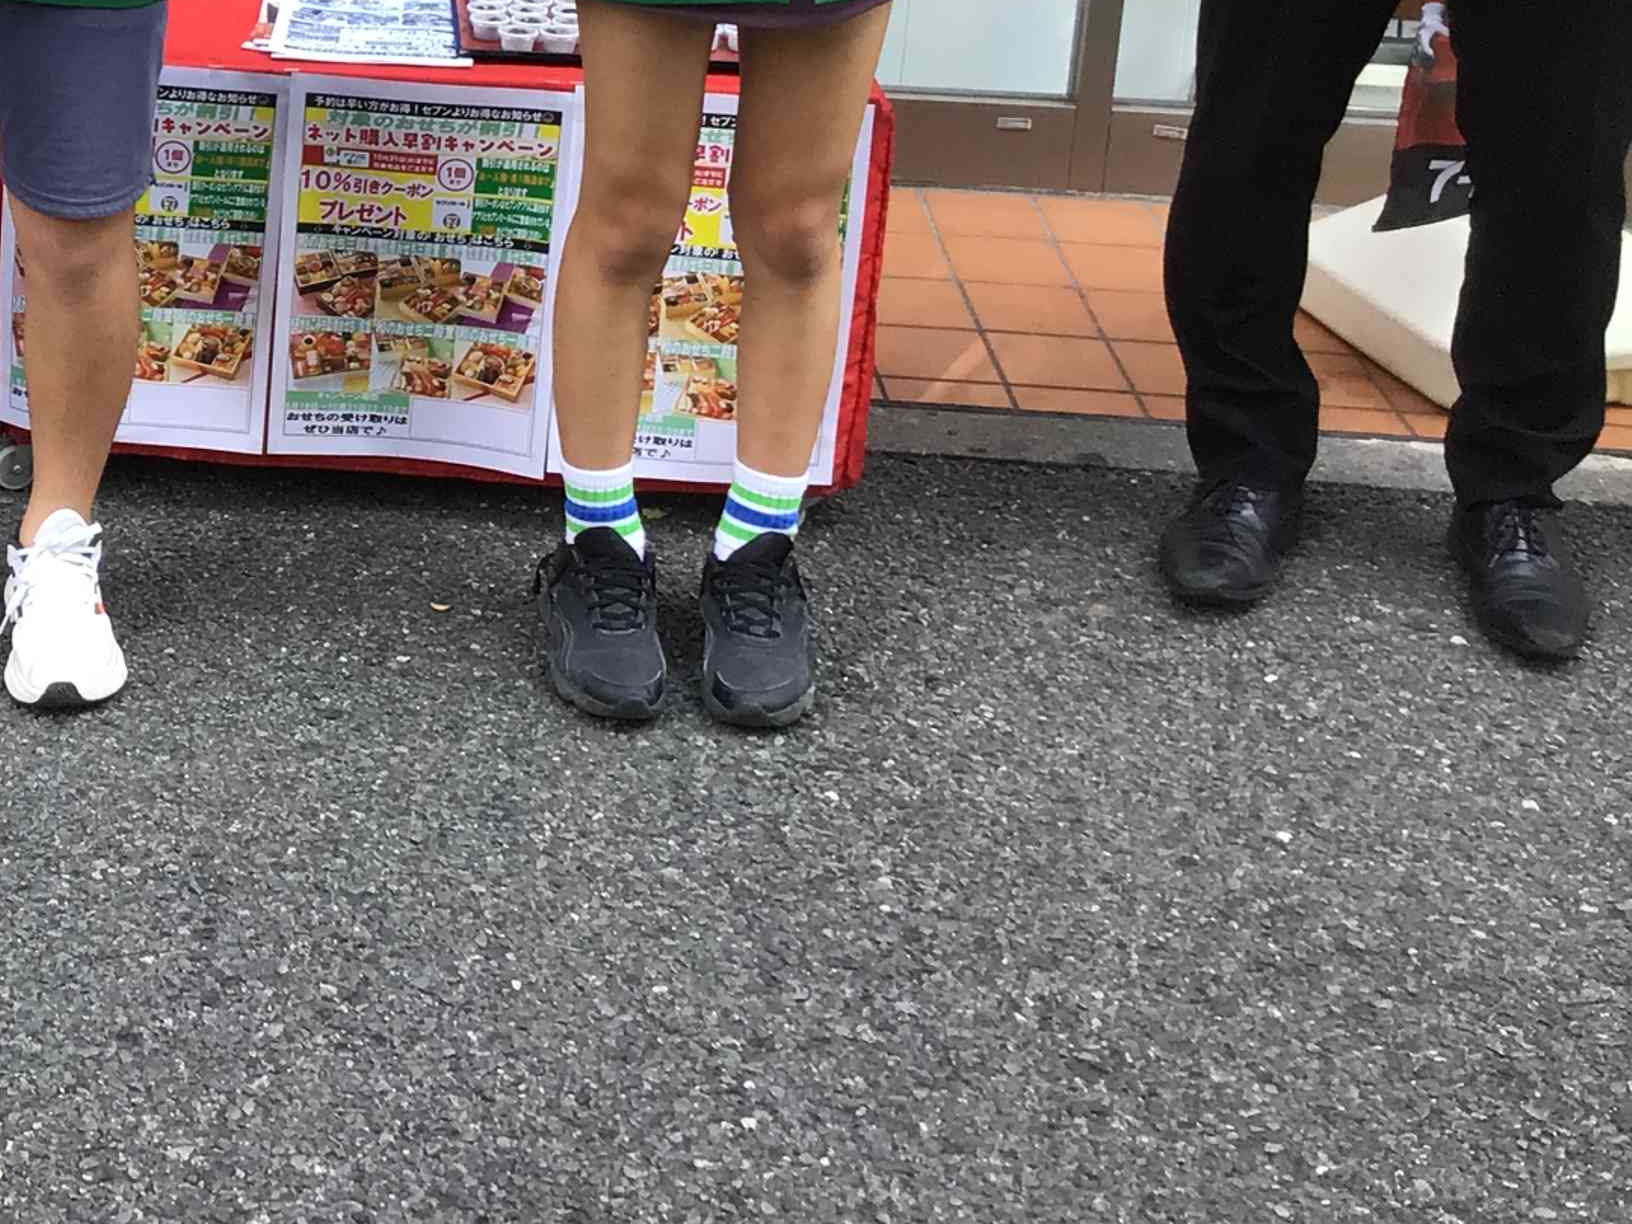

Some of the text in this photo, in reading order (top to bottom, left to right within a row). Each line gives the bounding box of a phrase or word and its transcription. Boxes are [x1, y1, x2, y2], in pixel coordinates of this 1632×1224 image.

[153, 117, 268, 138] キャンペーン
[307, 124, 555, 157] ネット購入早割キャンペーン
[302, 169, 435, 200] 10%引きクーポン
[446, 166, 467, 179] 1個
[318, 200, 408, 227] プレゼント
[287, 412, 408, 425] おせちの受け取りは
